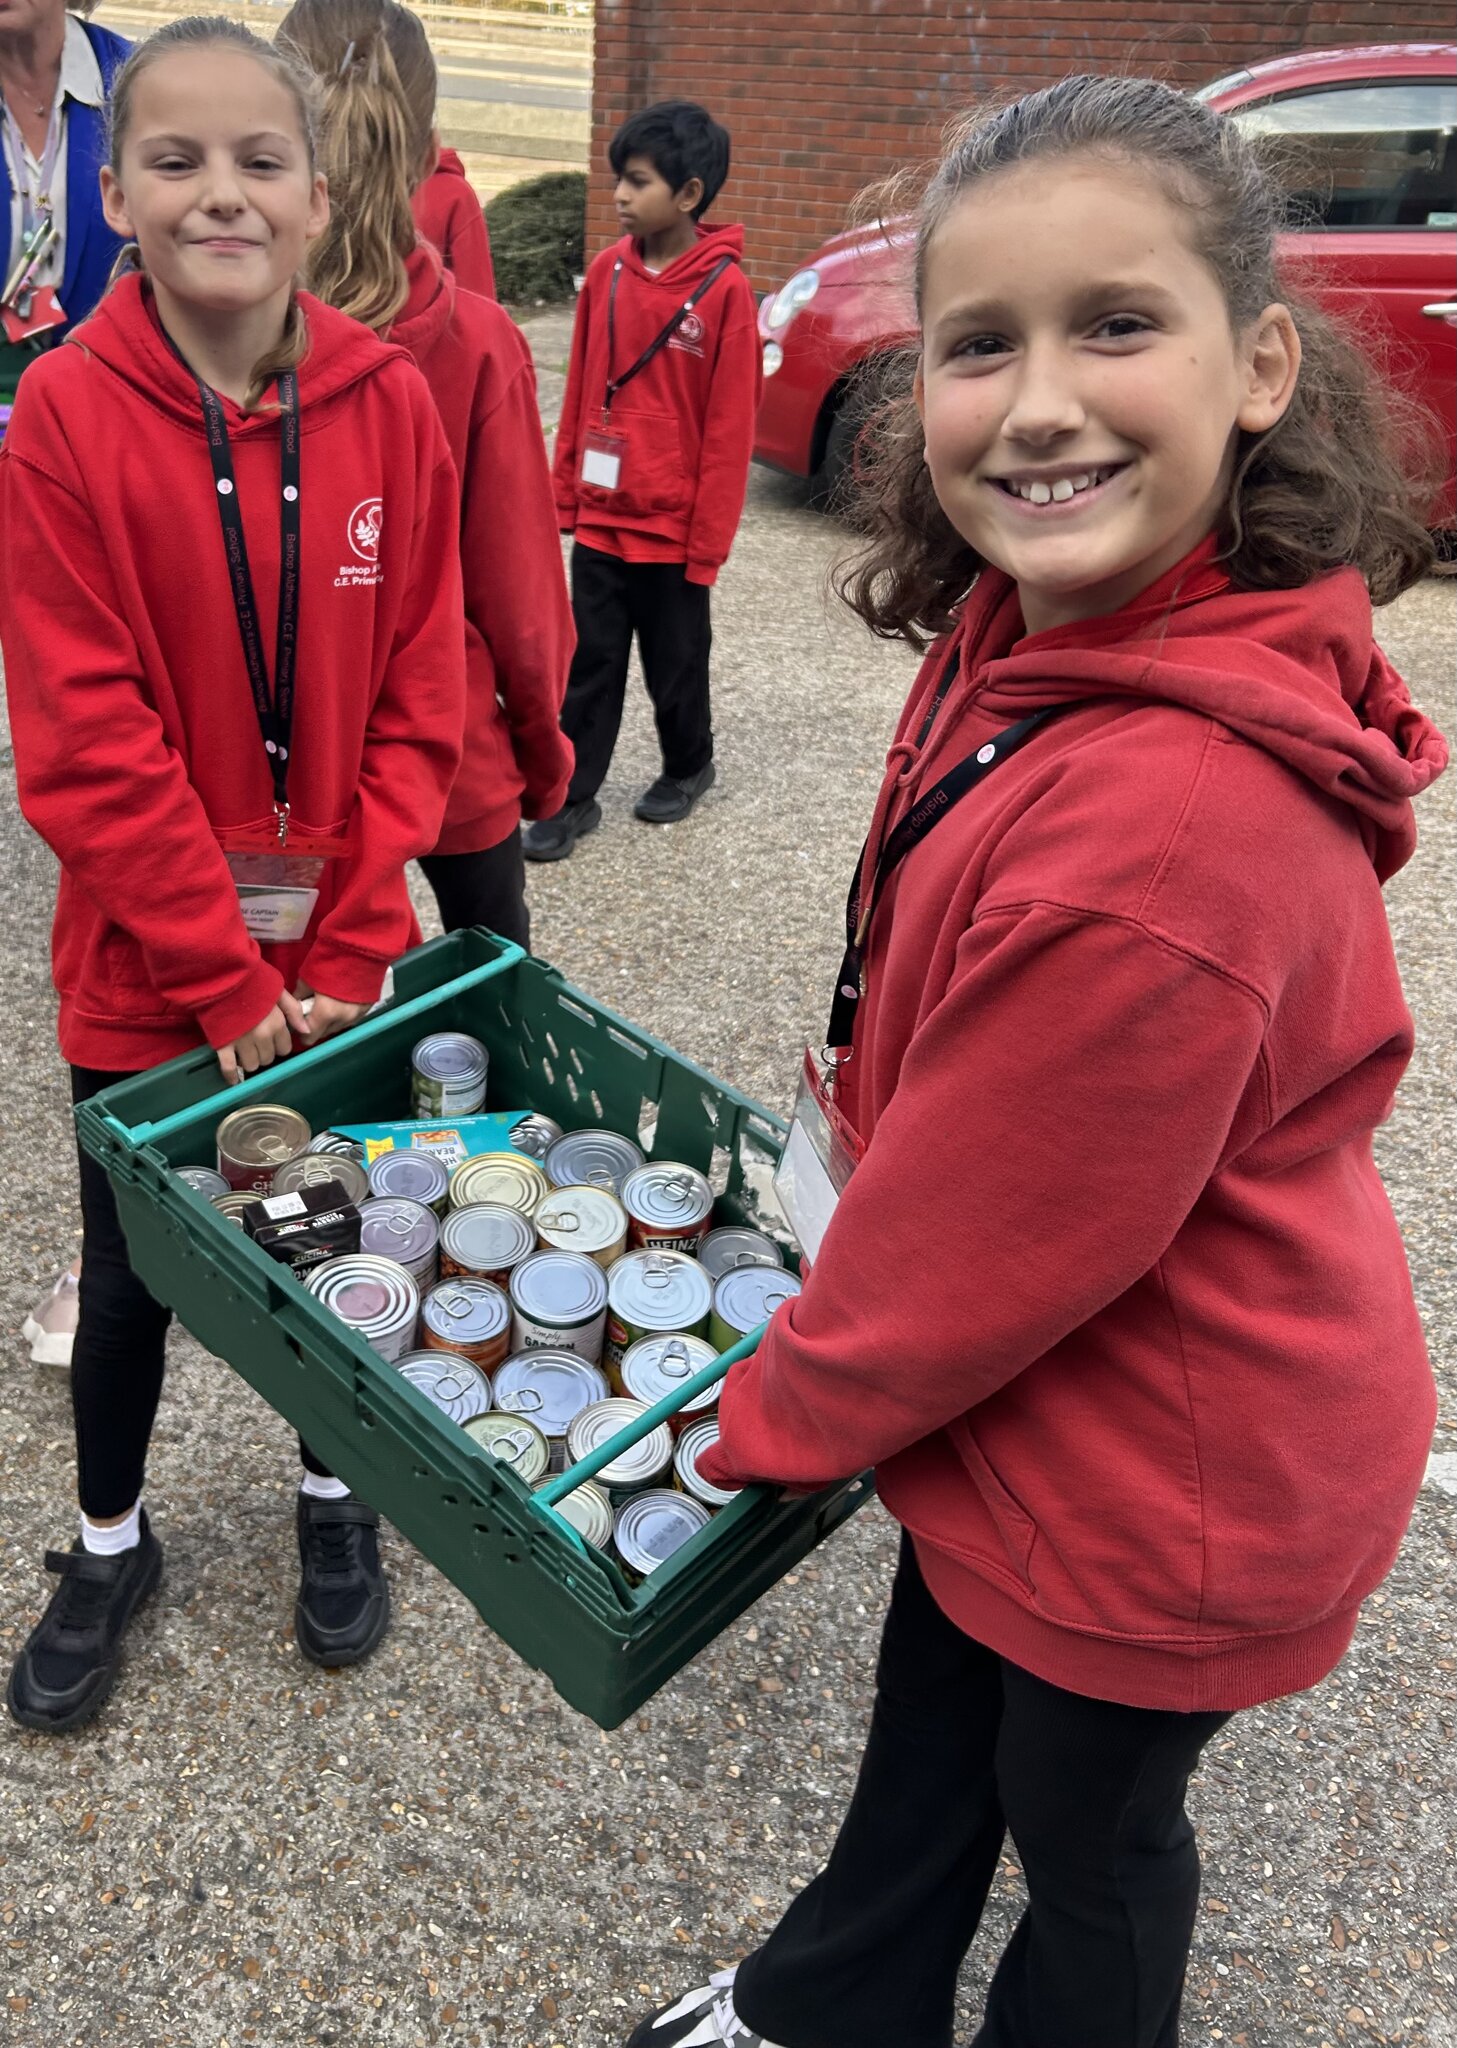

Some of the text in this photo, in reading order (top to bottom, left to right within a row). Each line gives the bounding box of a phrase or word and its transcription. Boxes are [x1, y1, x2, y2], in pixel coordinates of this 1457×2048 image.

[209, 408, 223, 446] Bishop
[287, 417, 296, 453] School
[226, 528, 241, 563] School
[286, 533, 296, 570] Bishop
[339, 565, 371, 576] Bishop
[334, 577, 350, 587] C.E.
[910, 789, 948, 829] Bishop
[251, 908, 279, 917] CAPTAIN
[650, 1238, 698, 1250] HEINZ
[295, 1250, 329, 1262] CUCINA
[530, 1326, 562, 1343] Simply
